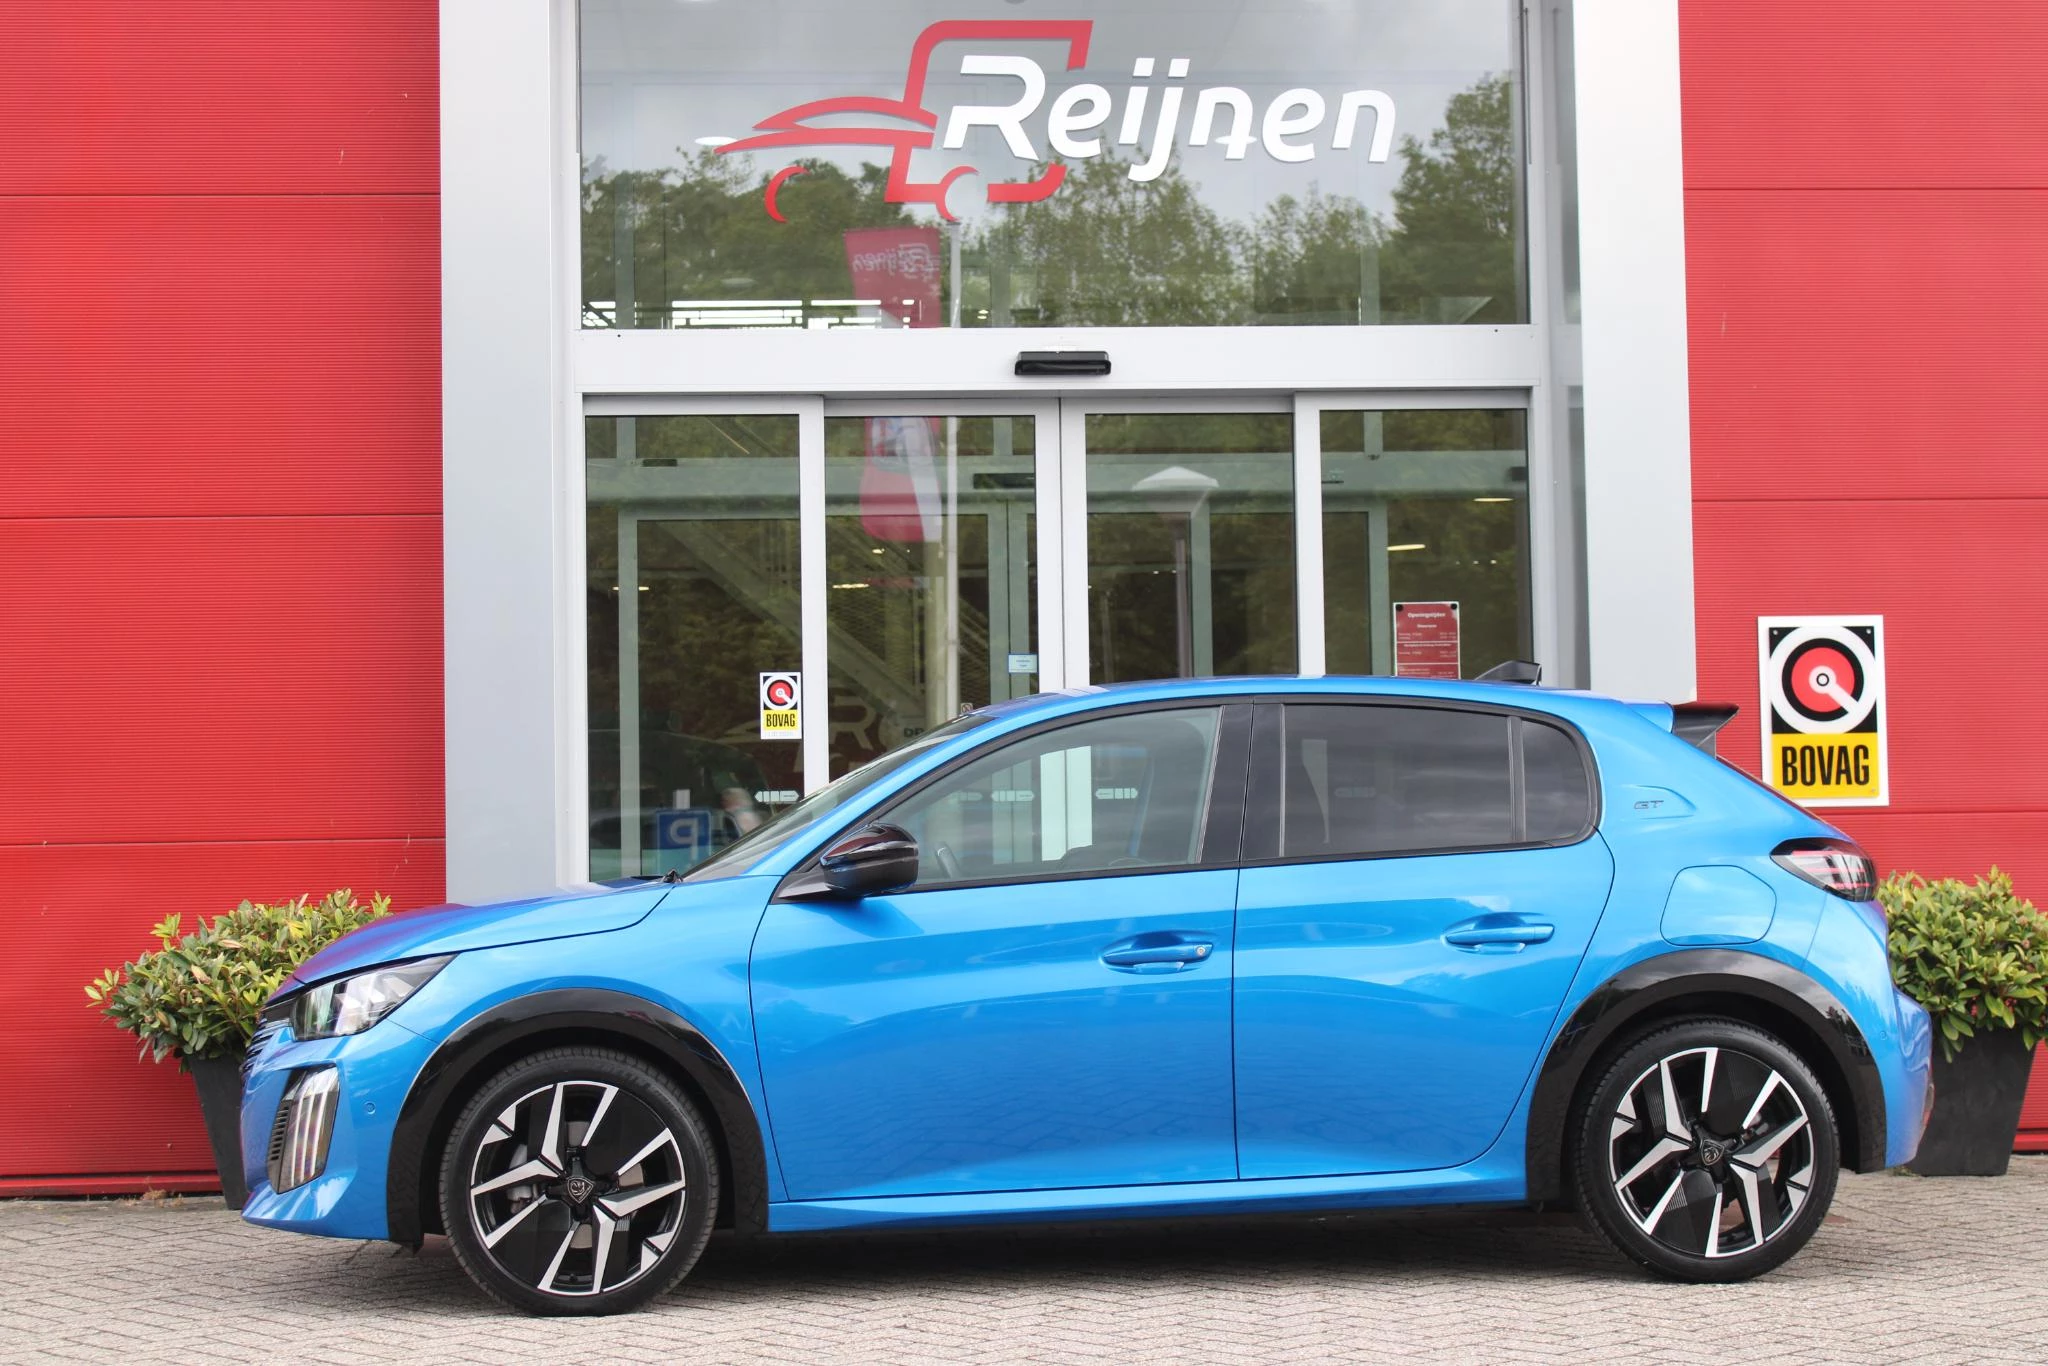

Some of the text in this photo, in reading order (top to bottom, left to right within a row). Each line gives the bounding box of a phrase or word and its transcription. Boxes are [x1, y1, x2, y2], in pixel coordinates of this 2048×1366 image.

[942, 54, 1397, 182] Reijnen
[766, 713, 796, 728] BOVAG
[1781, 744, 1870, 787] BOVAG
[1633, 800, 1664, 810] GT
